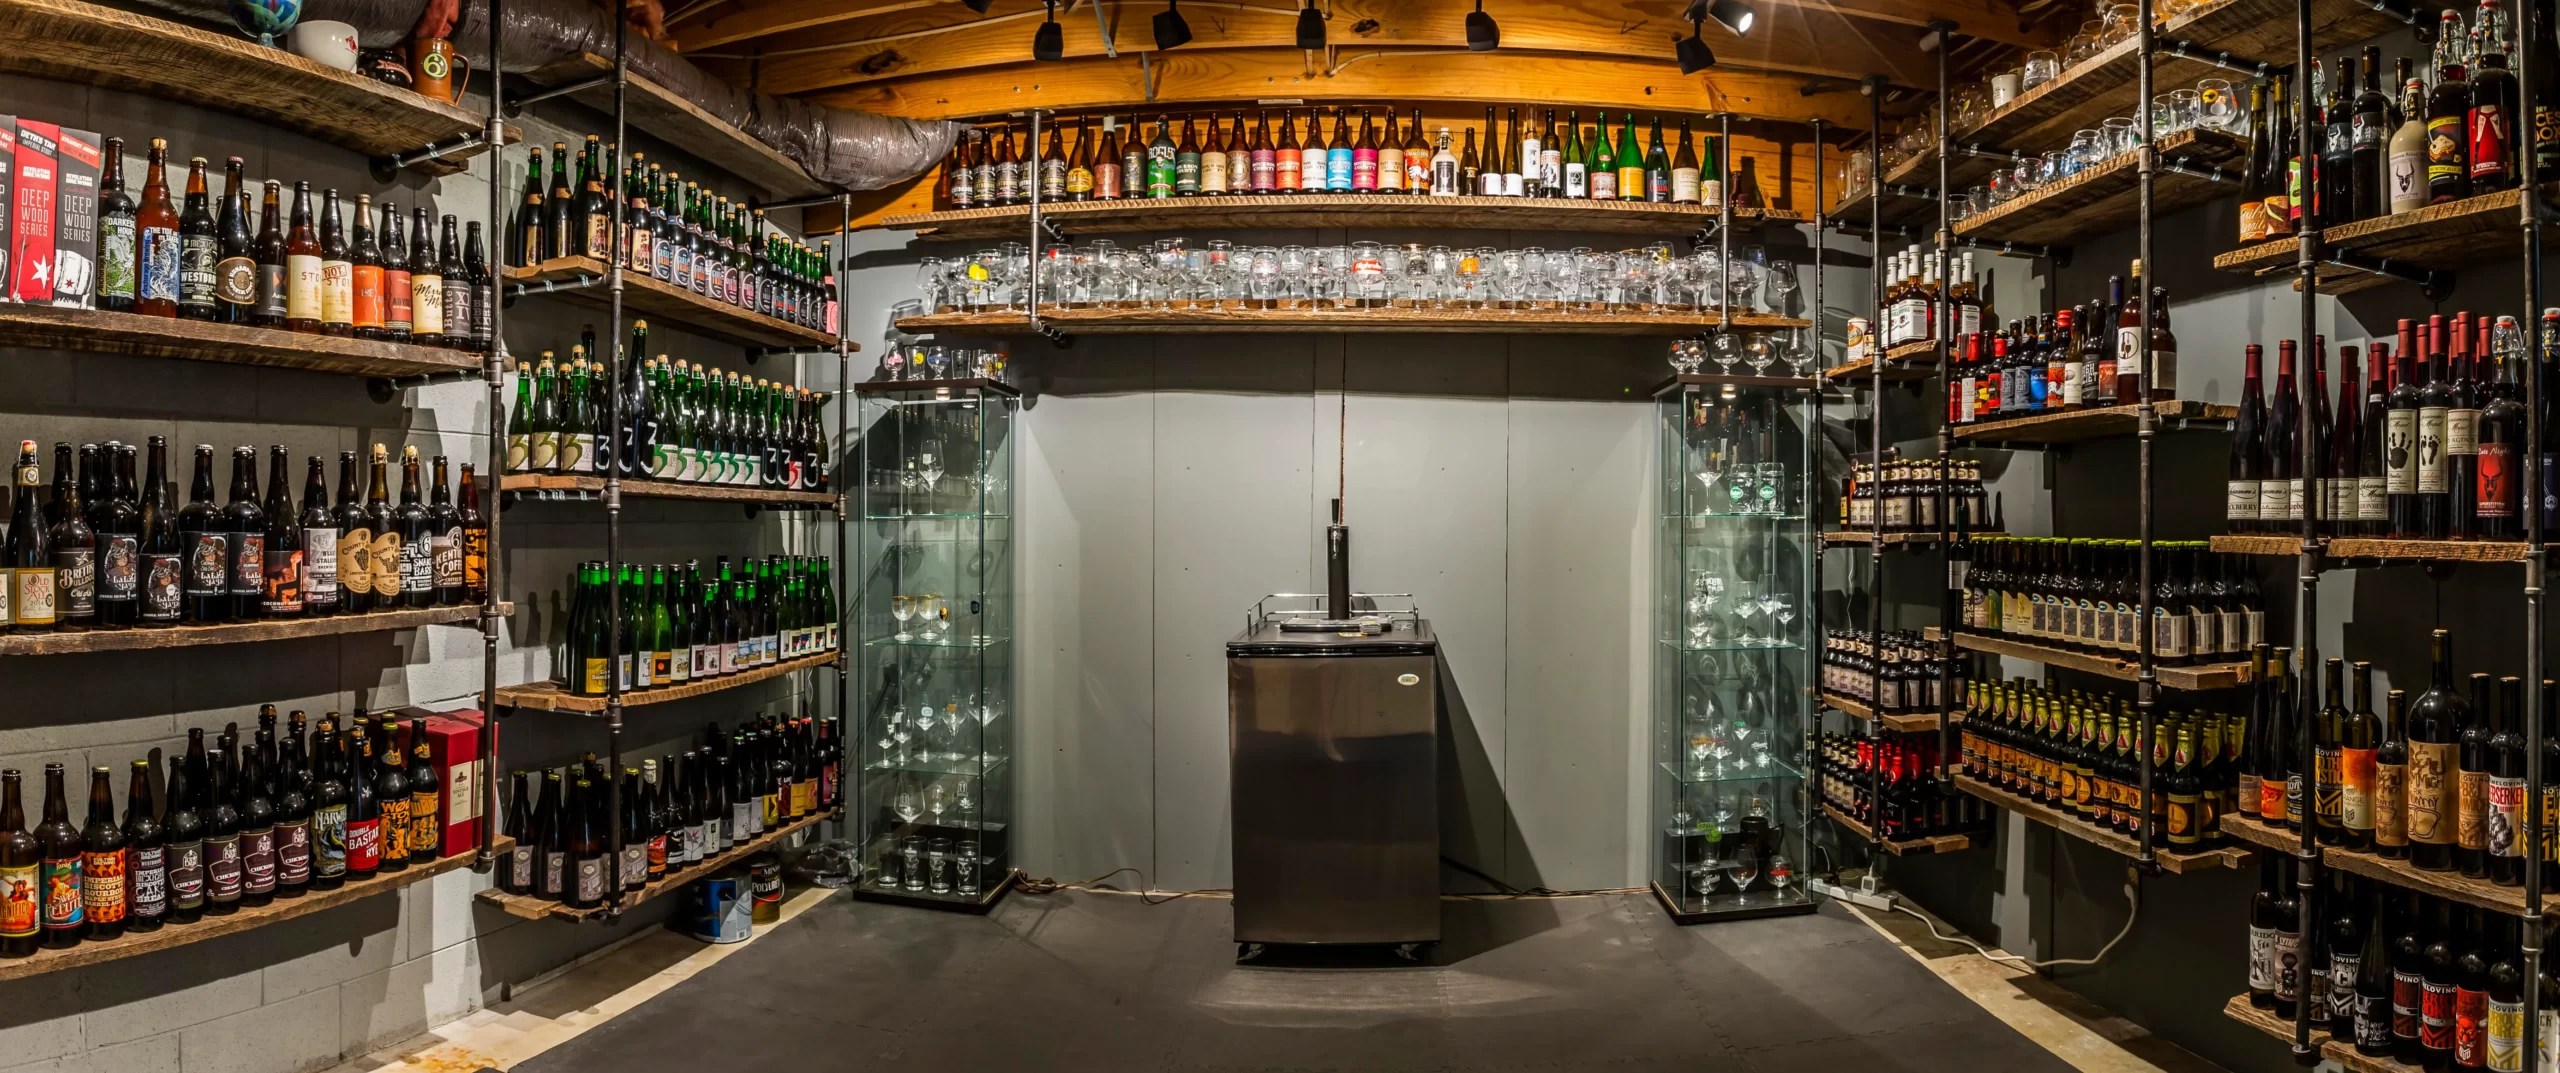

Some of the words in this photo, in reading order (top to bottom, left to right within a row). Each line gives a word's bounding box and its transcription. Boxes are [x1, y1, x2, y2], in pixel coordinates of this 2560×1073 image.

[22, 188, 49, 208] DEEP
[65, 195, 92, 215] DEEP
[21, 206, 48, 224] WOOD
[64, 212, 91, 230] WOOD
[21, 222, 48, 237] SERIES
[64, 228, 90, 243] SERIES
[324, 266, 342, 279] NOT
[444, 290, 454, 329] Butte
